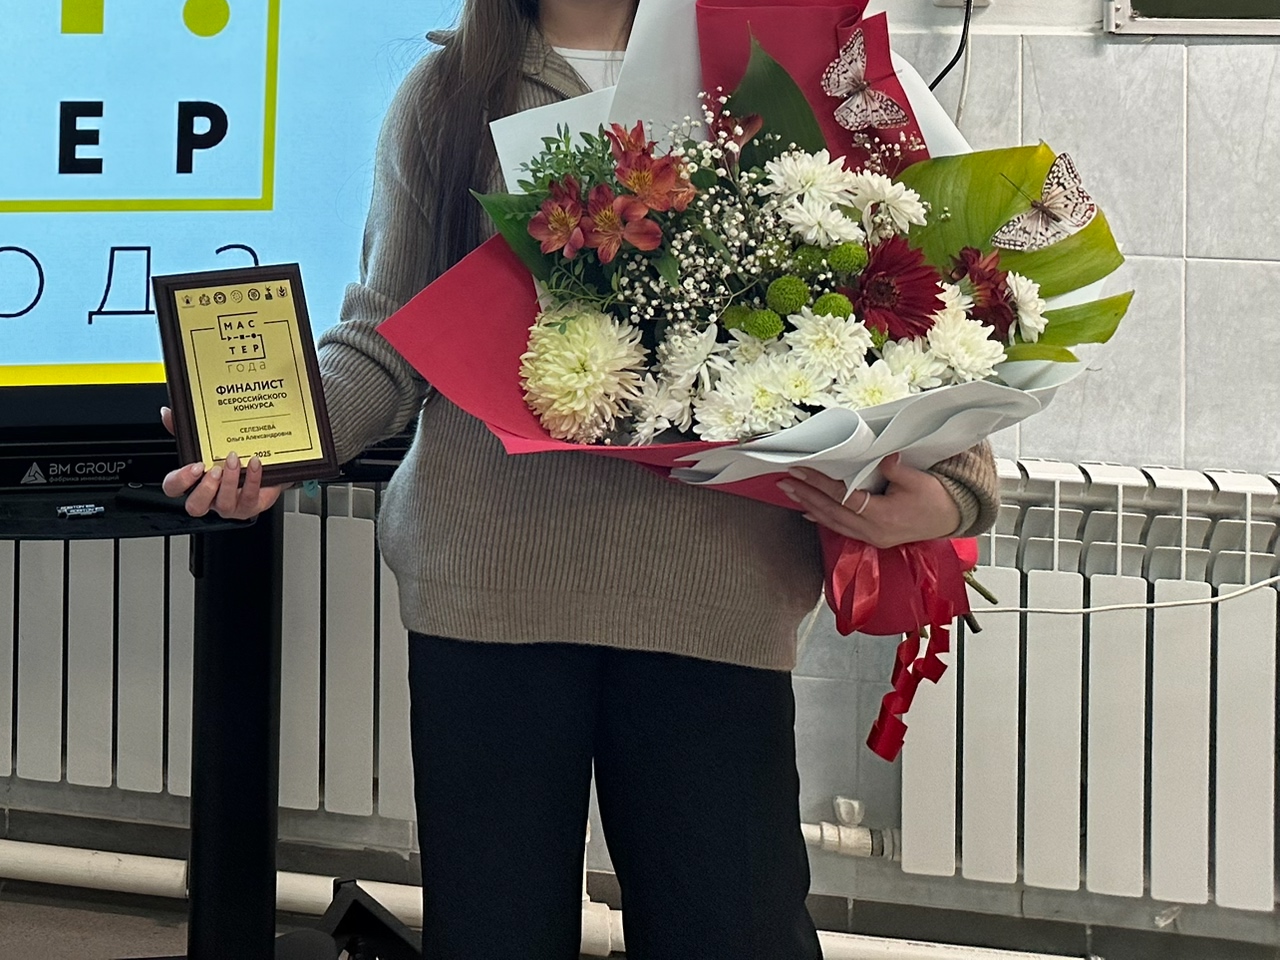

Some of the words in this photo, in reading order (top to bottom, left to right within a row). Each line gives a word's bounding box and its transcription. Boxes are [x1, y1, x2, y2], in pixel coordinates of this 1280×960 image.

[224, 320, 256, 331] МАС
[229, 344, 260, 355] ТЕР
[216, 379, 285, 396] ФИНАЛИСТ
[217, 391, 288, 406] ВСЕРОССИЙСКОГО
[233, 401, 275, 412] КОНКУРСА
[239, 424, 276, 434] СЕЛЕЗНЕВА
[226, 434, 244, 443] Ольга
[245, 429, 292, 441] Александровна
[49, 463, 71, 475] BM
[75, 462, 126, 474] GROUP
